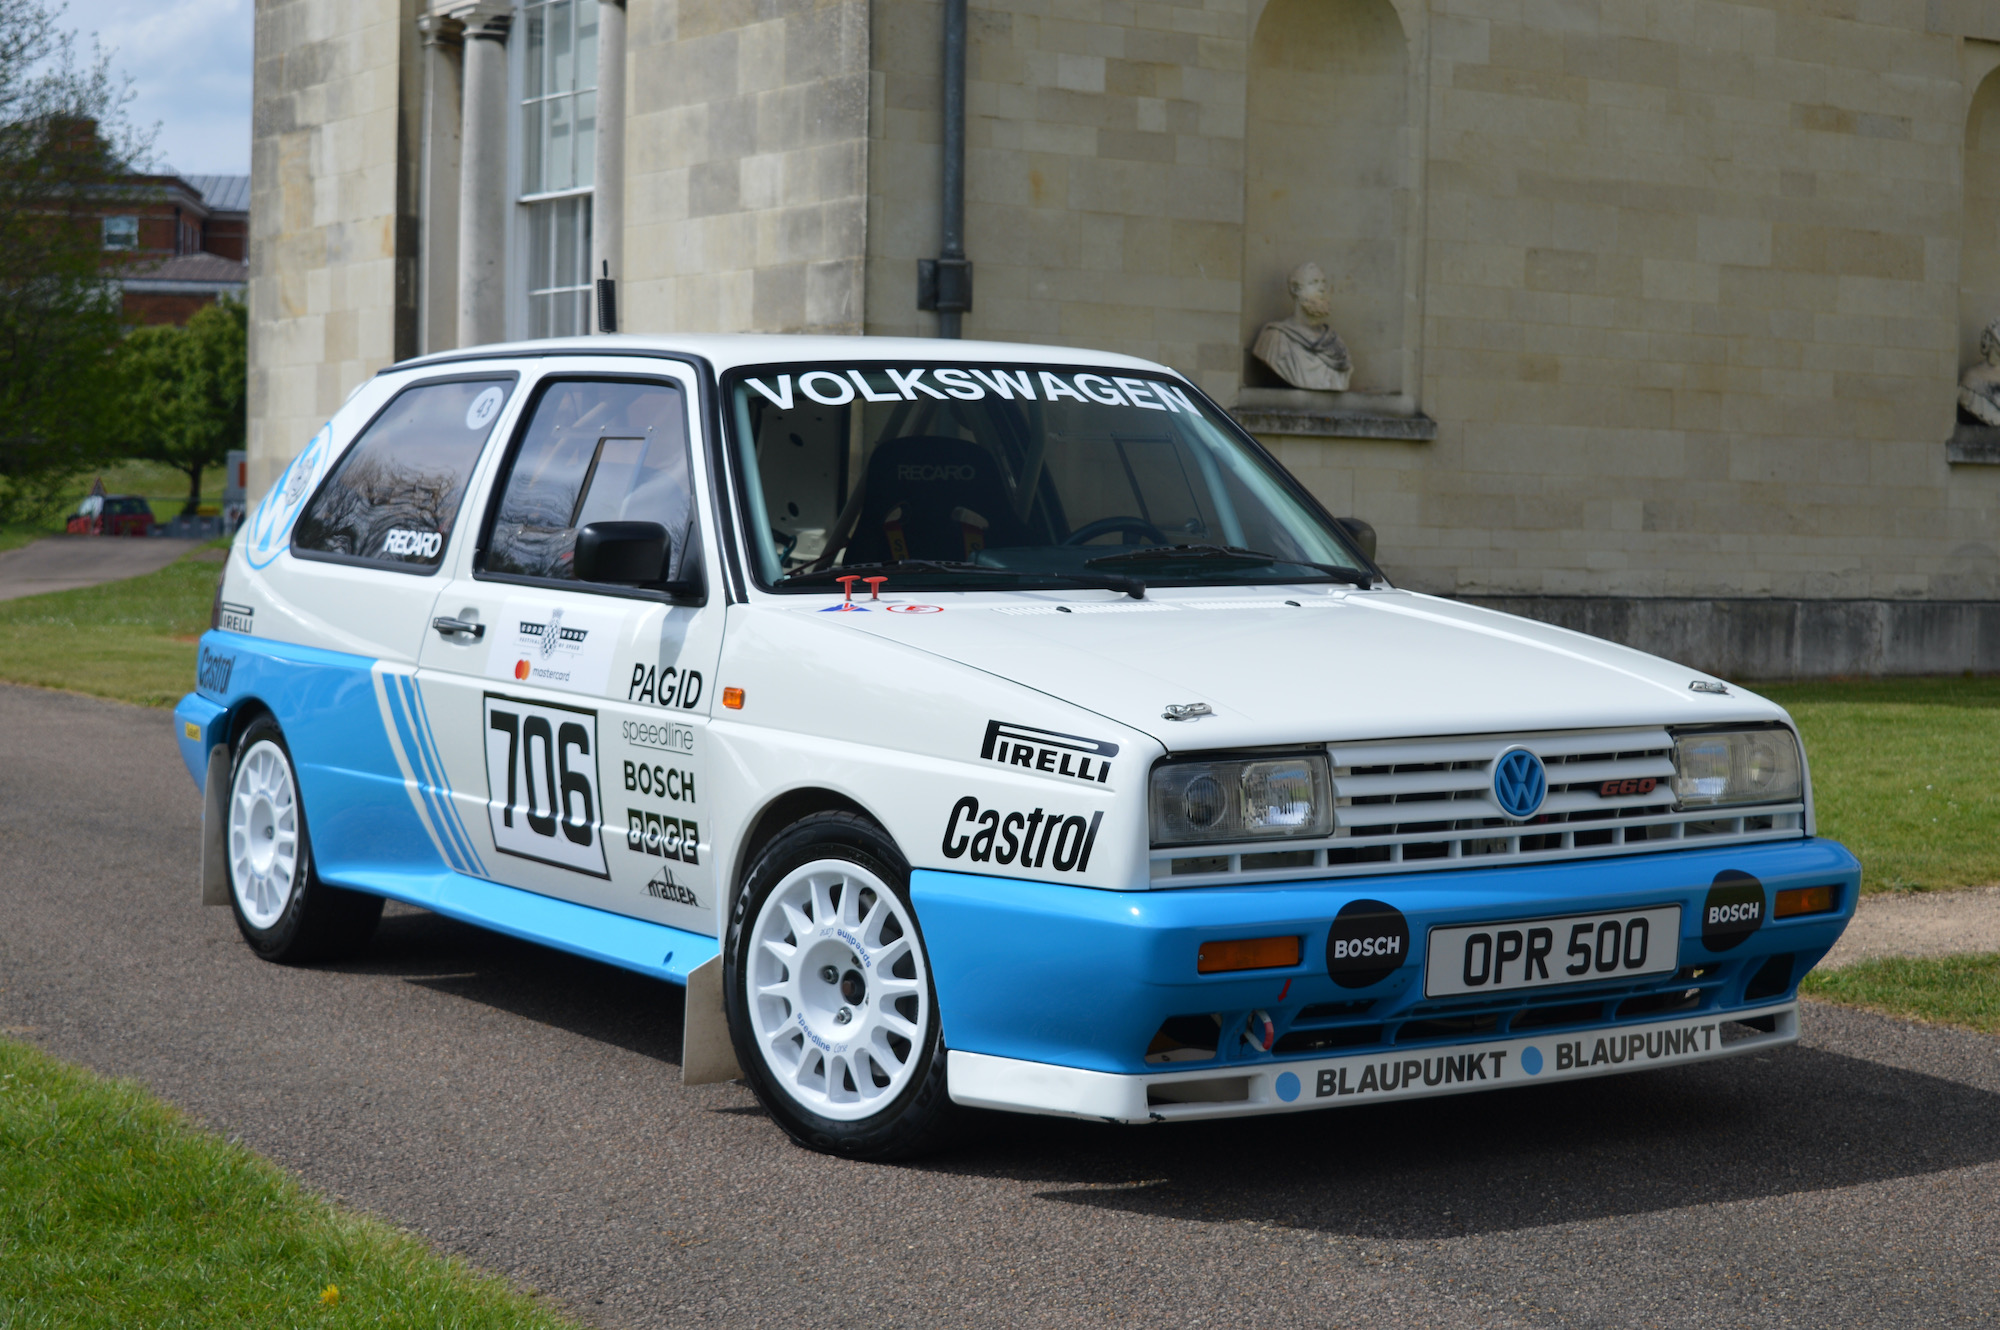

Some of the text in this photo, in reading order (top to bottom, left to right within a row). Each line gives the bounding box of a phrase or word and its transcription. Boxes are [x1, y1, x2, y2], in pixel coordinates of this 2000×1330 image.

[477, 398, 494, 418] 43
[744, 368, 1202, 417] VOLKSWAGEN
[898, 465, 975, 480] RECARO
[383, 529, 442, 558] RECARO
[199, 646, 236, 695] Castrol
[533, 667, 570, 682] mastercard
[628, 663, 703, 709] PAGID
[623, 719, 694, 752] speedline
[980, 719, 1120, 784] PIRELLI
[491, 709, 594, 847] 706
[623, 760, 696, 803] BOSCH
[1600, 778, 1657, 796] G60
[630, 811, 698, 861] BOGE
[942, 795, 1105, 873] Castrol
[1708, 902, 1759, 924] BOSCH
[837, 928, 872, 968] speedline
[1334, 936, 1400, 959] BOSCH
[1463, 918, 1649, 987] OPR 500
[797, 1011, 831, 1052] speedline
[1315, 1024, 1716, 1098] BLAUPUNKT BLAUPUNKT
